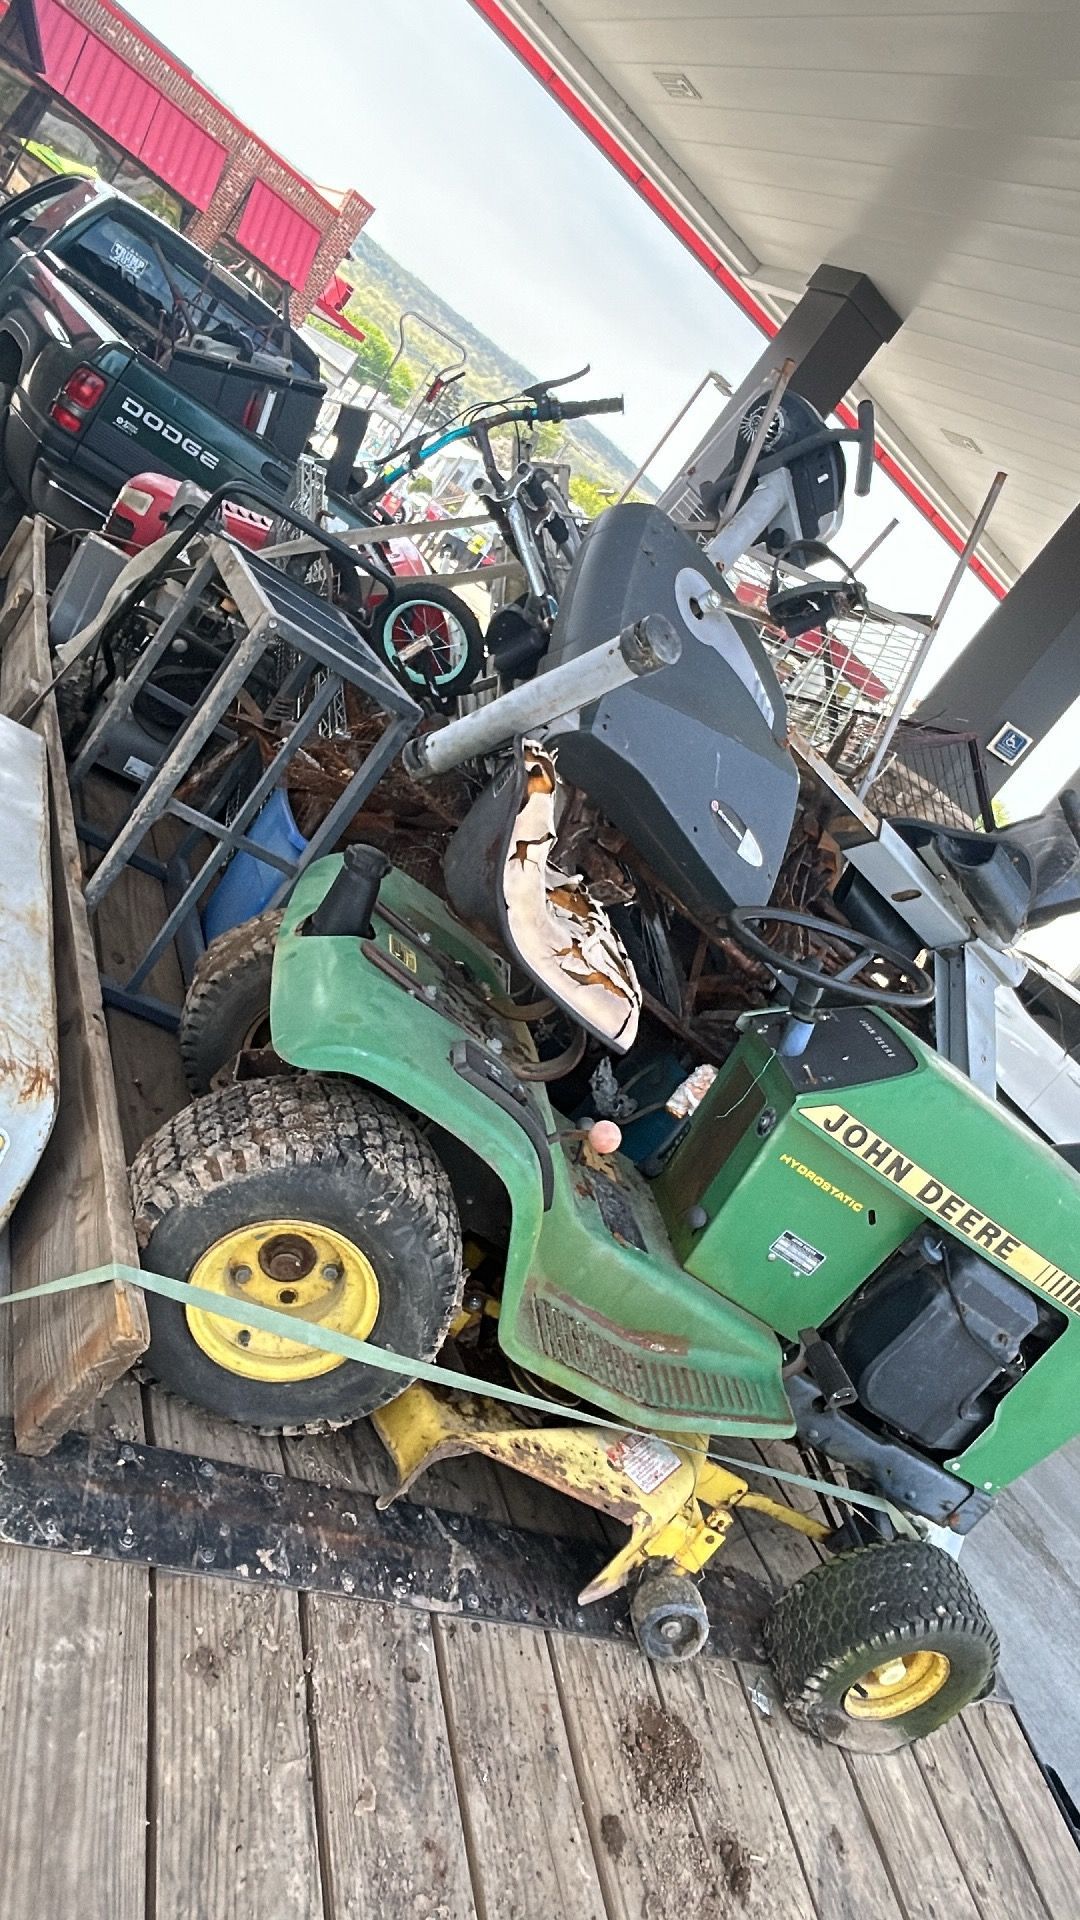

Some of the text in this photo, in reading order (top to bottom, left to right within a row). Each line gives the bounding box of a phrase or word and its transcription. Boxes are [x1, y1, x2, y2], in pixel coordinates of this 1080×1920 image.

[122, 397, 219, 470] DODGE
[874, 1036, 896, 1057] DEERE
[780, 1154, 864, 1212] HYDROSTATIC
[823, 1113, 1021, 1261] JOHN DEERE
